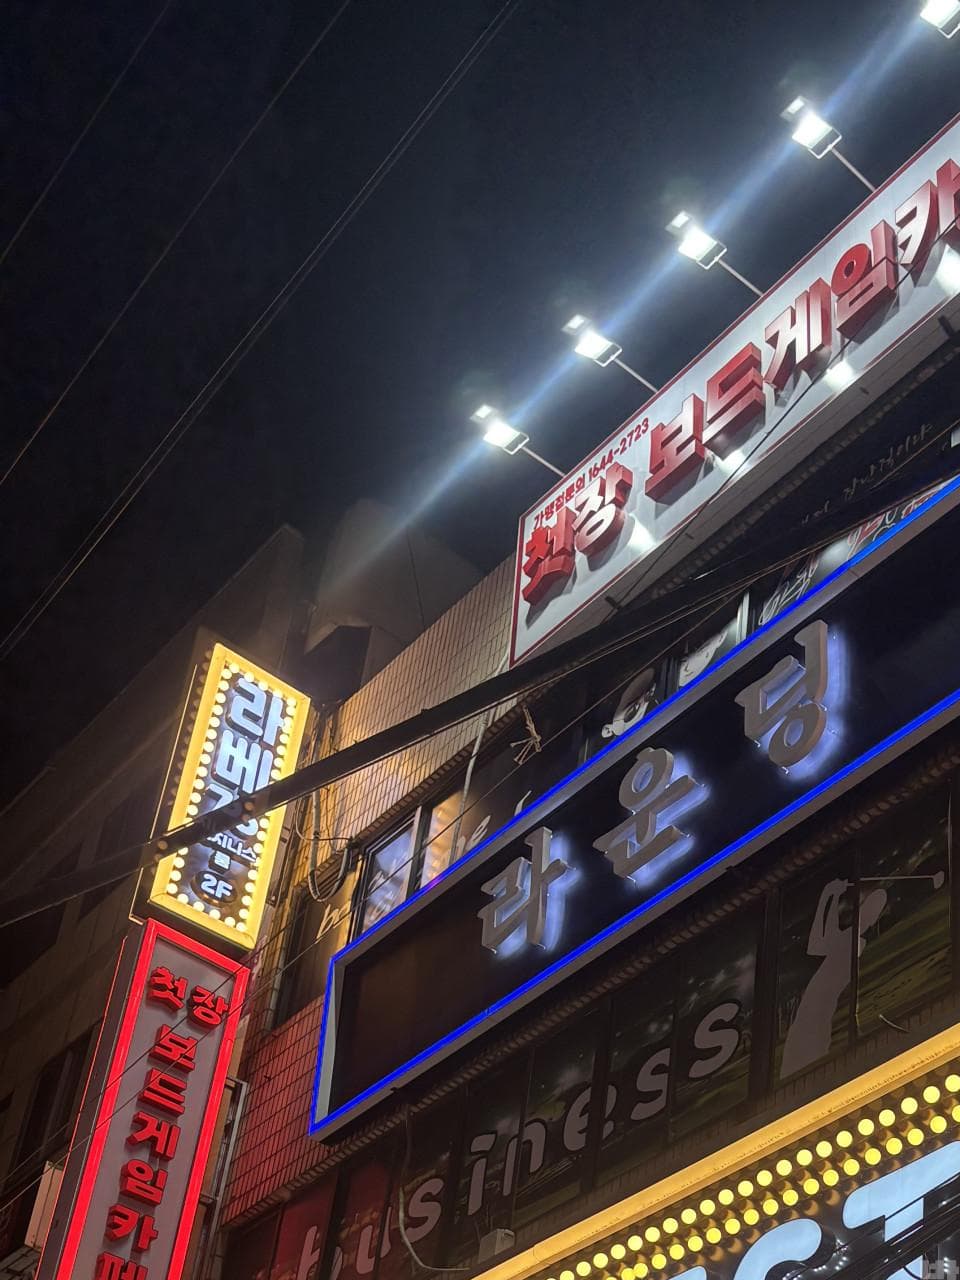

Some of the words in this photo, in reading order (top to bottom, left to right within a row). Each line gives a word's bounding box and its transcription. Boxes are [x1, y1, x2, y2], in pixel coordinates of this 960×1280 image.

[588, 417, 650, 482] 1644-2723
[215, 677, 285, 794] 라베
[476, 618, 832, 953] 라운딩
[199, 873, 233, 899] 2F
[147, 965, 230, 1028] 첫장
